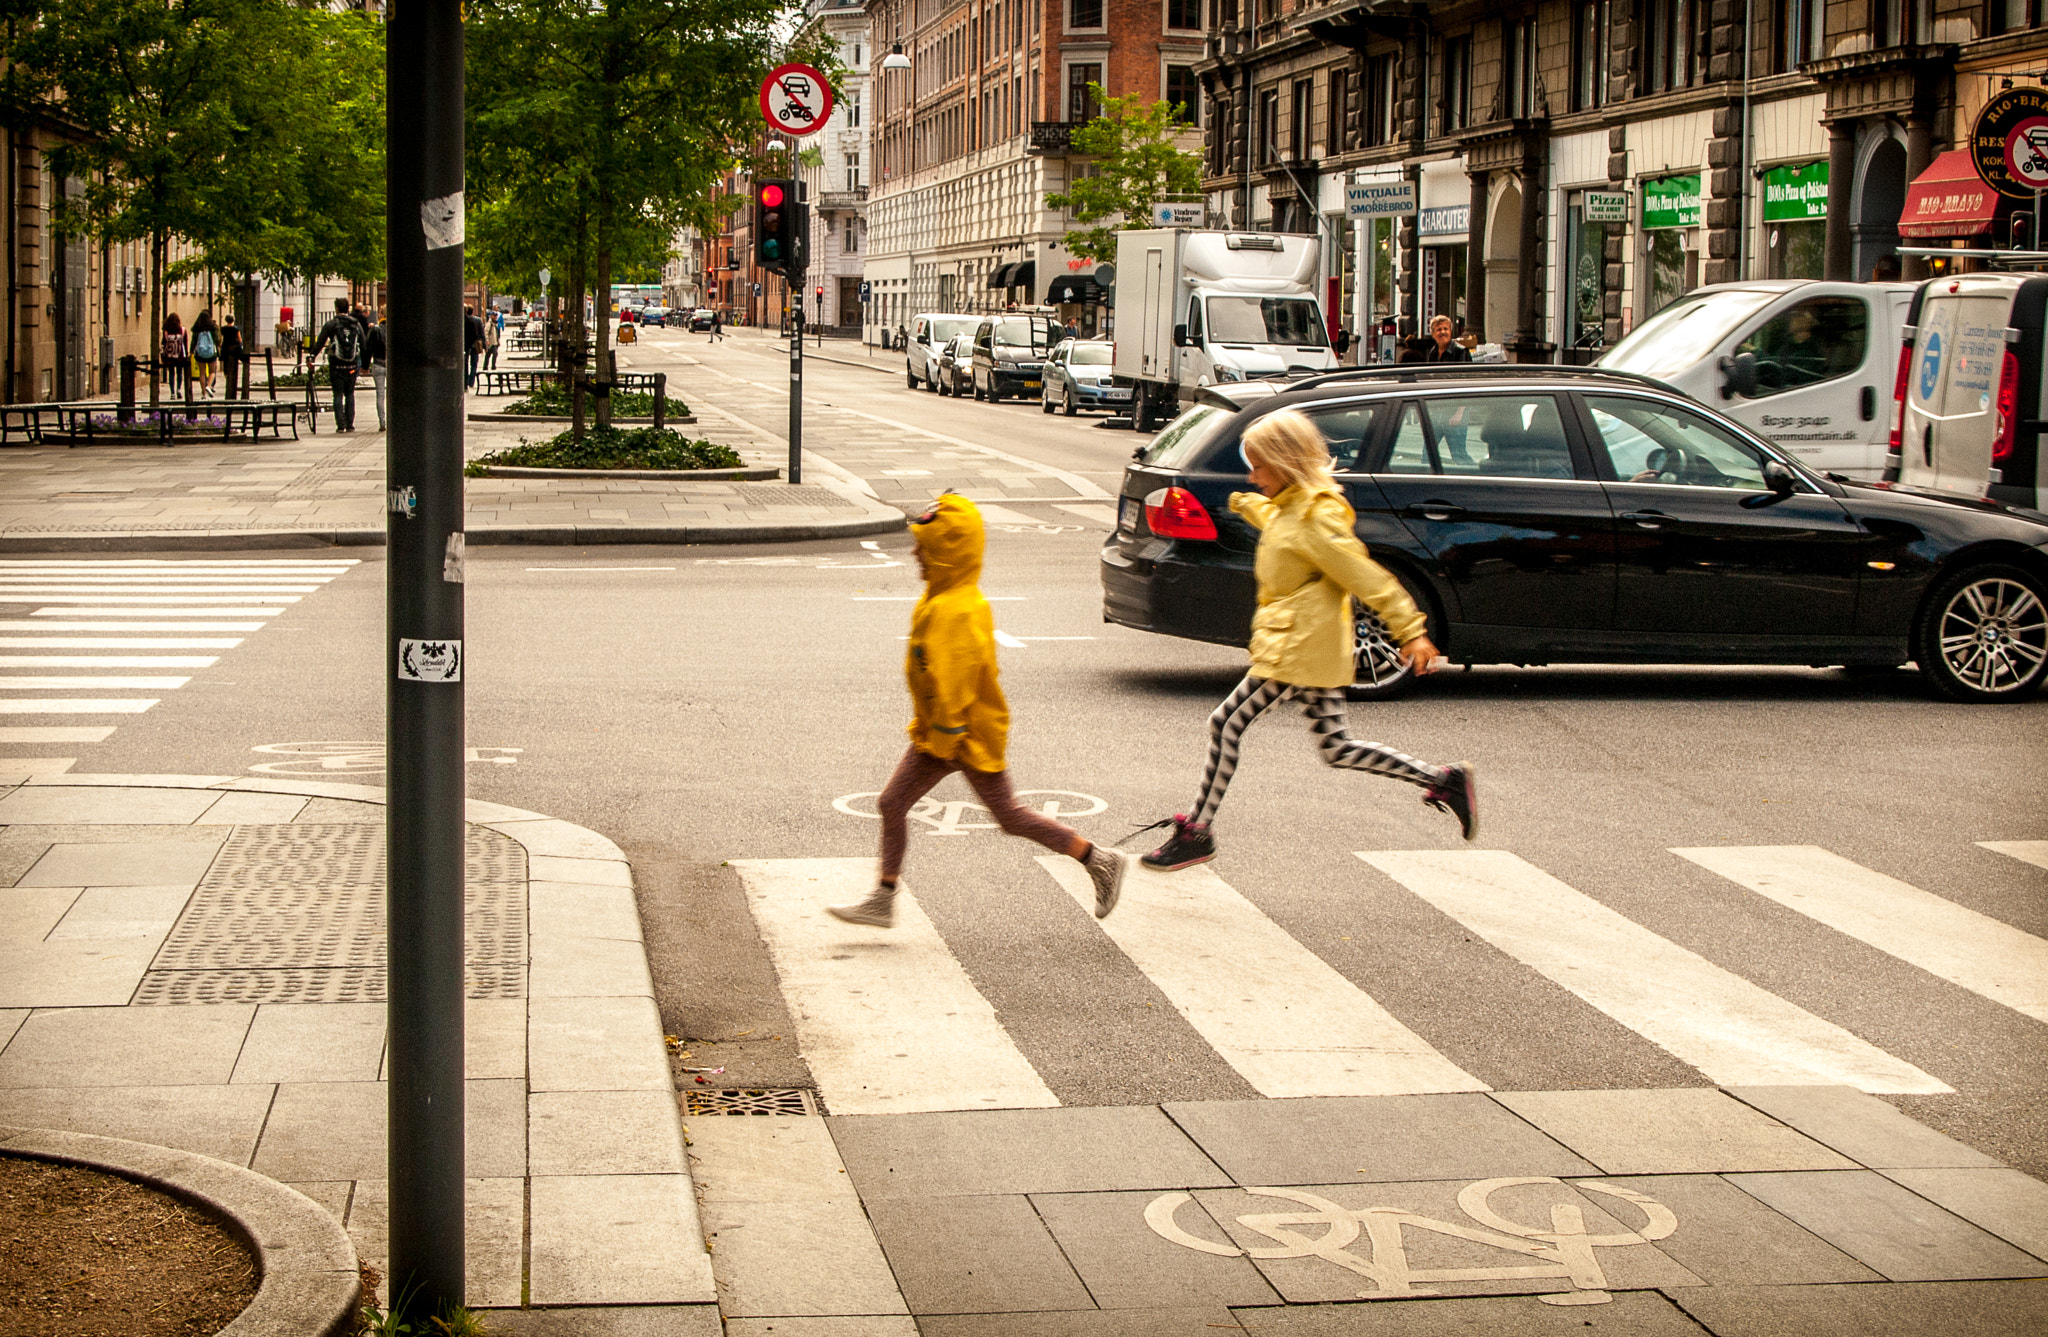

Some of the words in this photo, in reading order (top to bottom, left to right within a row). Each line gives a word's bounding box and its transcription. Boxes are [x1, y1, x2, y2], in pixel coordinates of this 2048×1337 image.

[1979, 136, 2006, 148] RES
[1349, 186, 1411, 199] VIKTUALIE
[1785, 184, 1799, 201] Pizza
[1590, 194, 1625, 205] Pizza
[1661, 194, 1673, 211] Pizza
[1174, 208, 1201, 216] Vindrose
[1807, 203, 1819, 215] Take
[1679, 212, 1690, 224] Take
[861, 283, 868, 293] P
